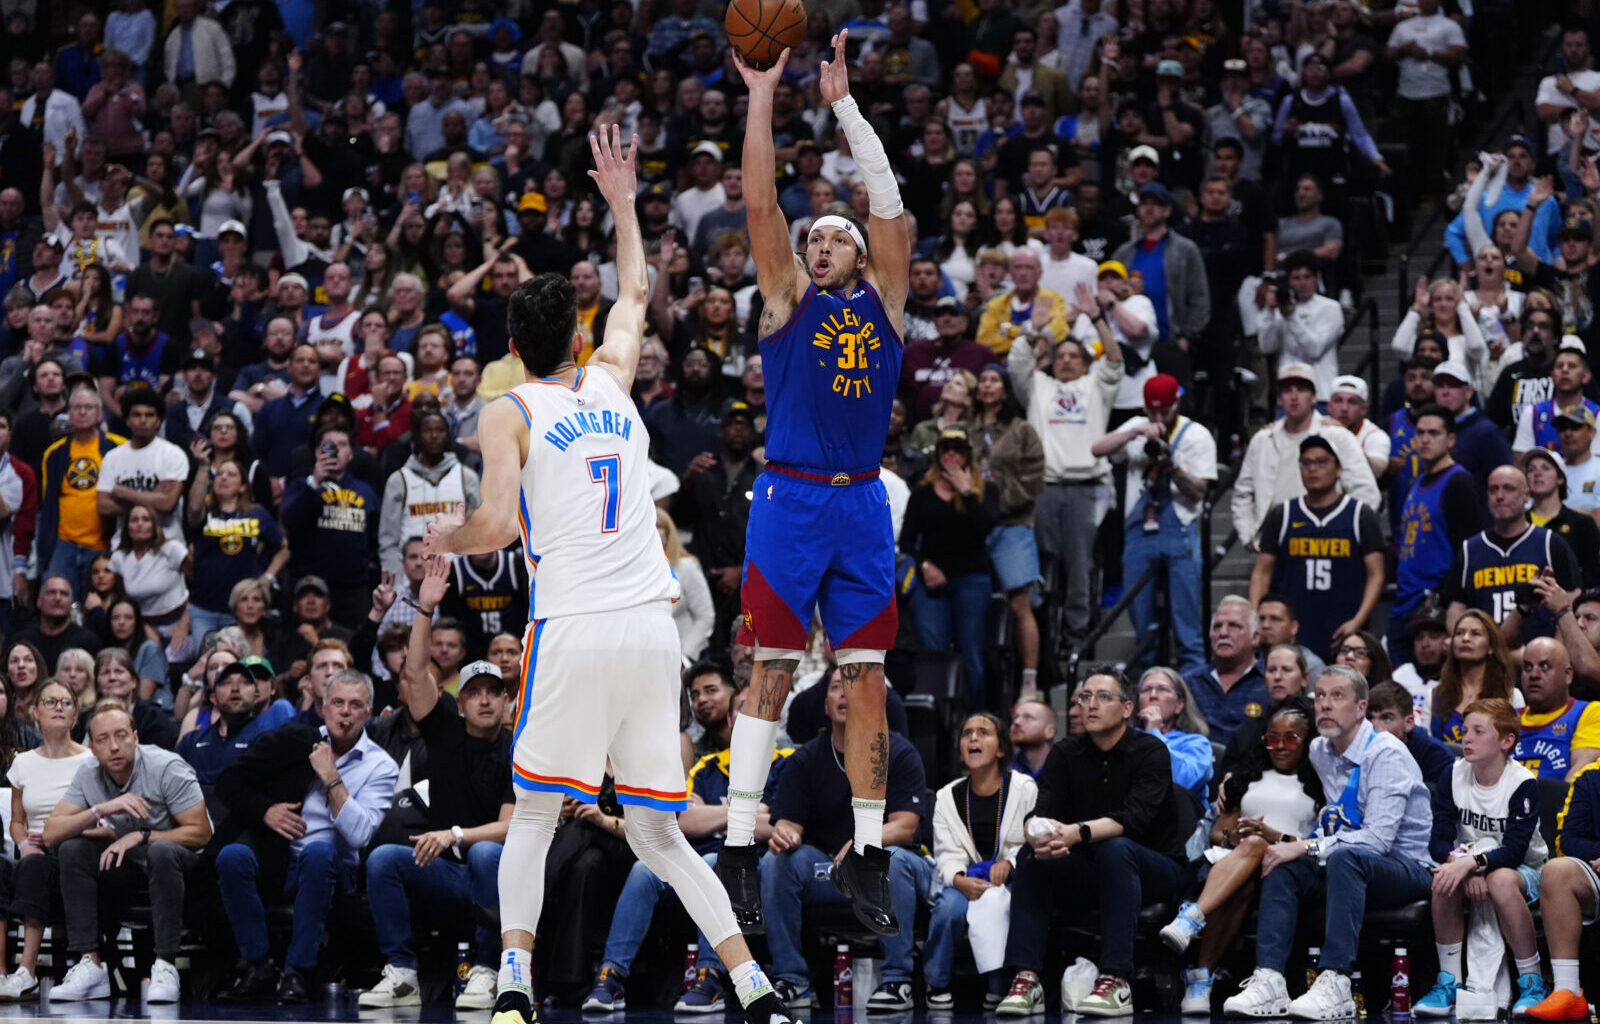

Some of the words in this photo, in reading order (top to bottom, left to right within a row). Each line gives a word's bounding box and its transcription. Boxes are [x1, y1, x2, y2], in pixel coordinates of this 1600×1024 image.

[812, 308, 854, 350] MILE
[837, 332, 868, 369] 32
[832, 374, 872, 399] CITY
[544, 410, 632, 452] HOLMGREN
[585, 453, 621, 534] 7
[409, 501, 464, 517] NUGGET
[1289, 537, 1351, 557] DENVER
[1305, 559, 1332, 591] 15
[1473, 563, 1538, 589] DENVER
[480, 611, 501, 633] 15
[1533, 740, 1567, 770] HIGH
